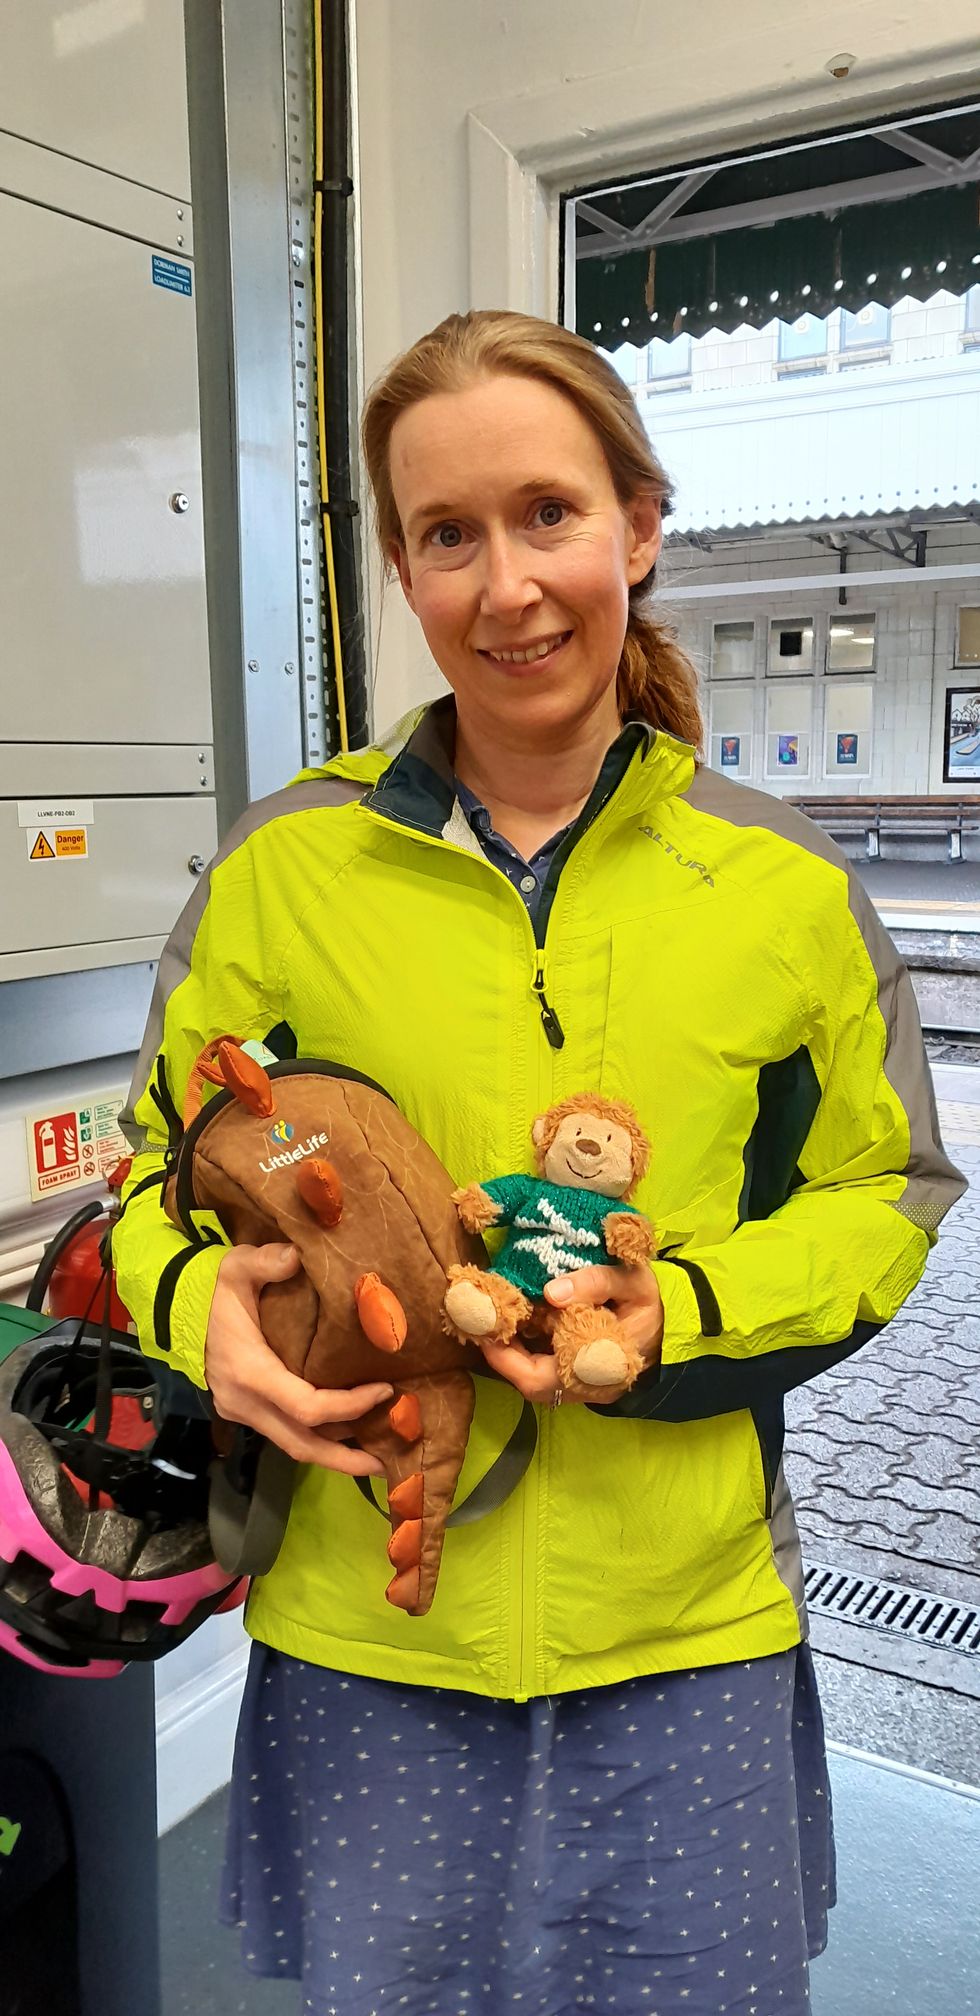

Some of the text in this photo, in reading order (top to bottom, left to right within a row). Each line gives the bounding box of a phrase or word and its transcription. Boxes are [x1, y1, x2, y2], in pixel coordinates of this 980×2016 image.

[57, 835, 84, 844] Danger
[638, 825, 714, 888] ALTURA
[259, 1132, 329, 1172] LittleLife
[42, 1170, 77, 1186] FOAM SPRAY
